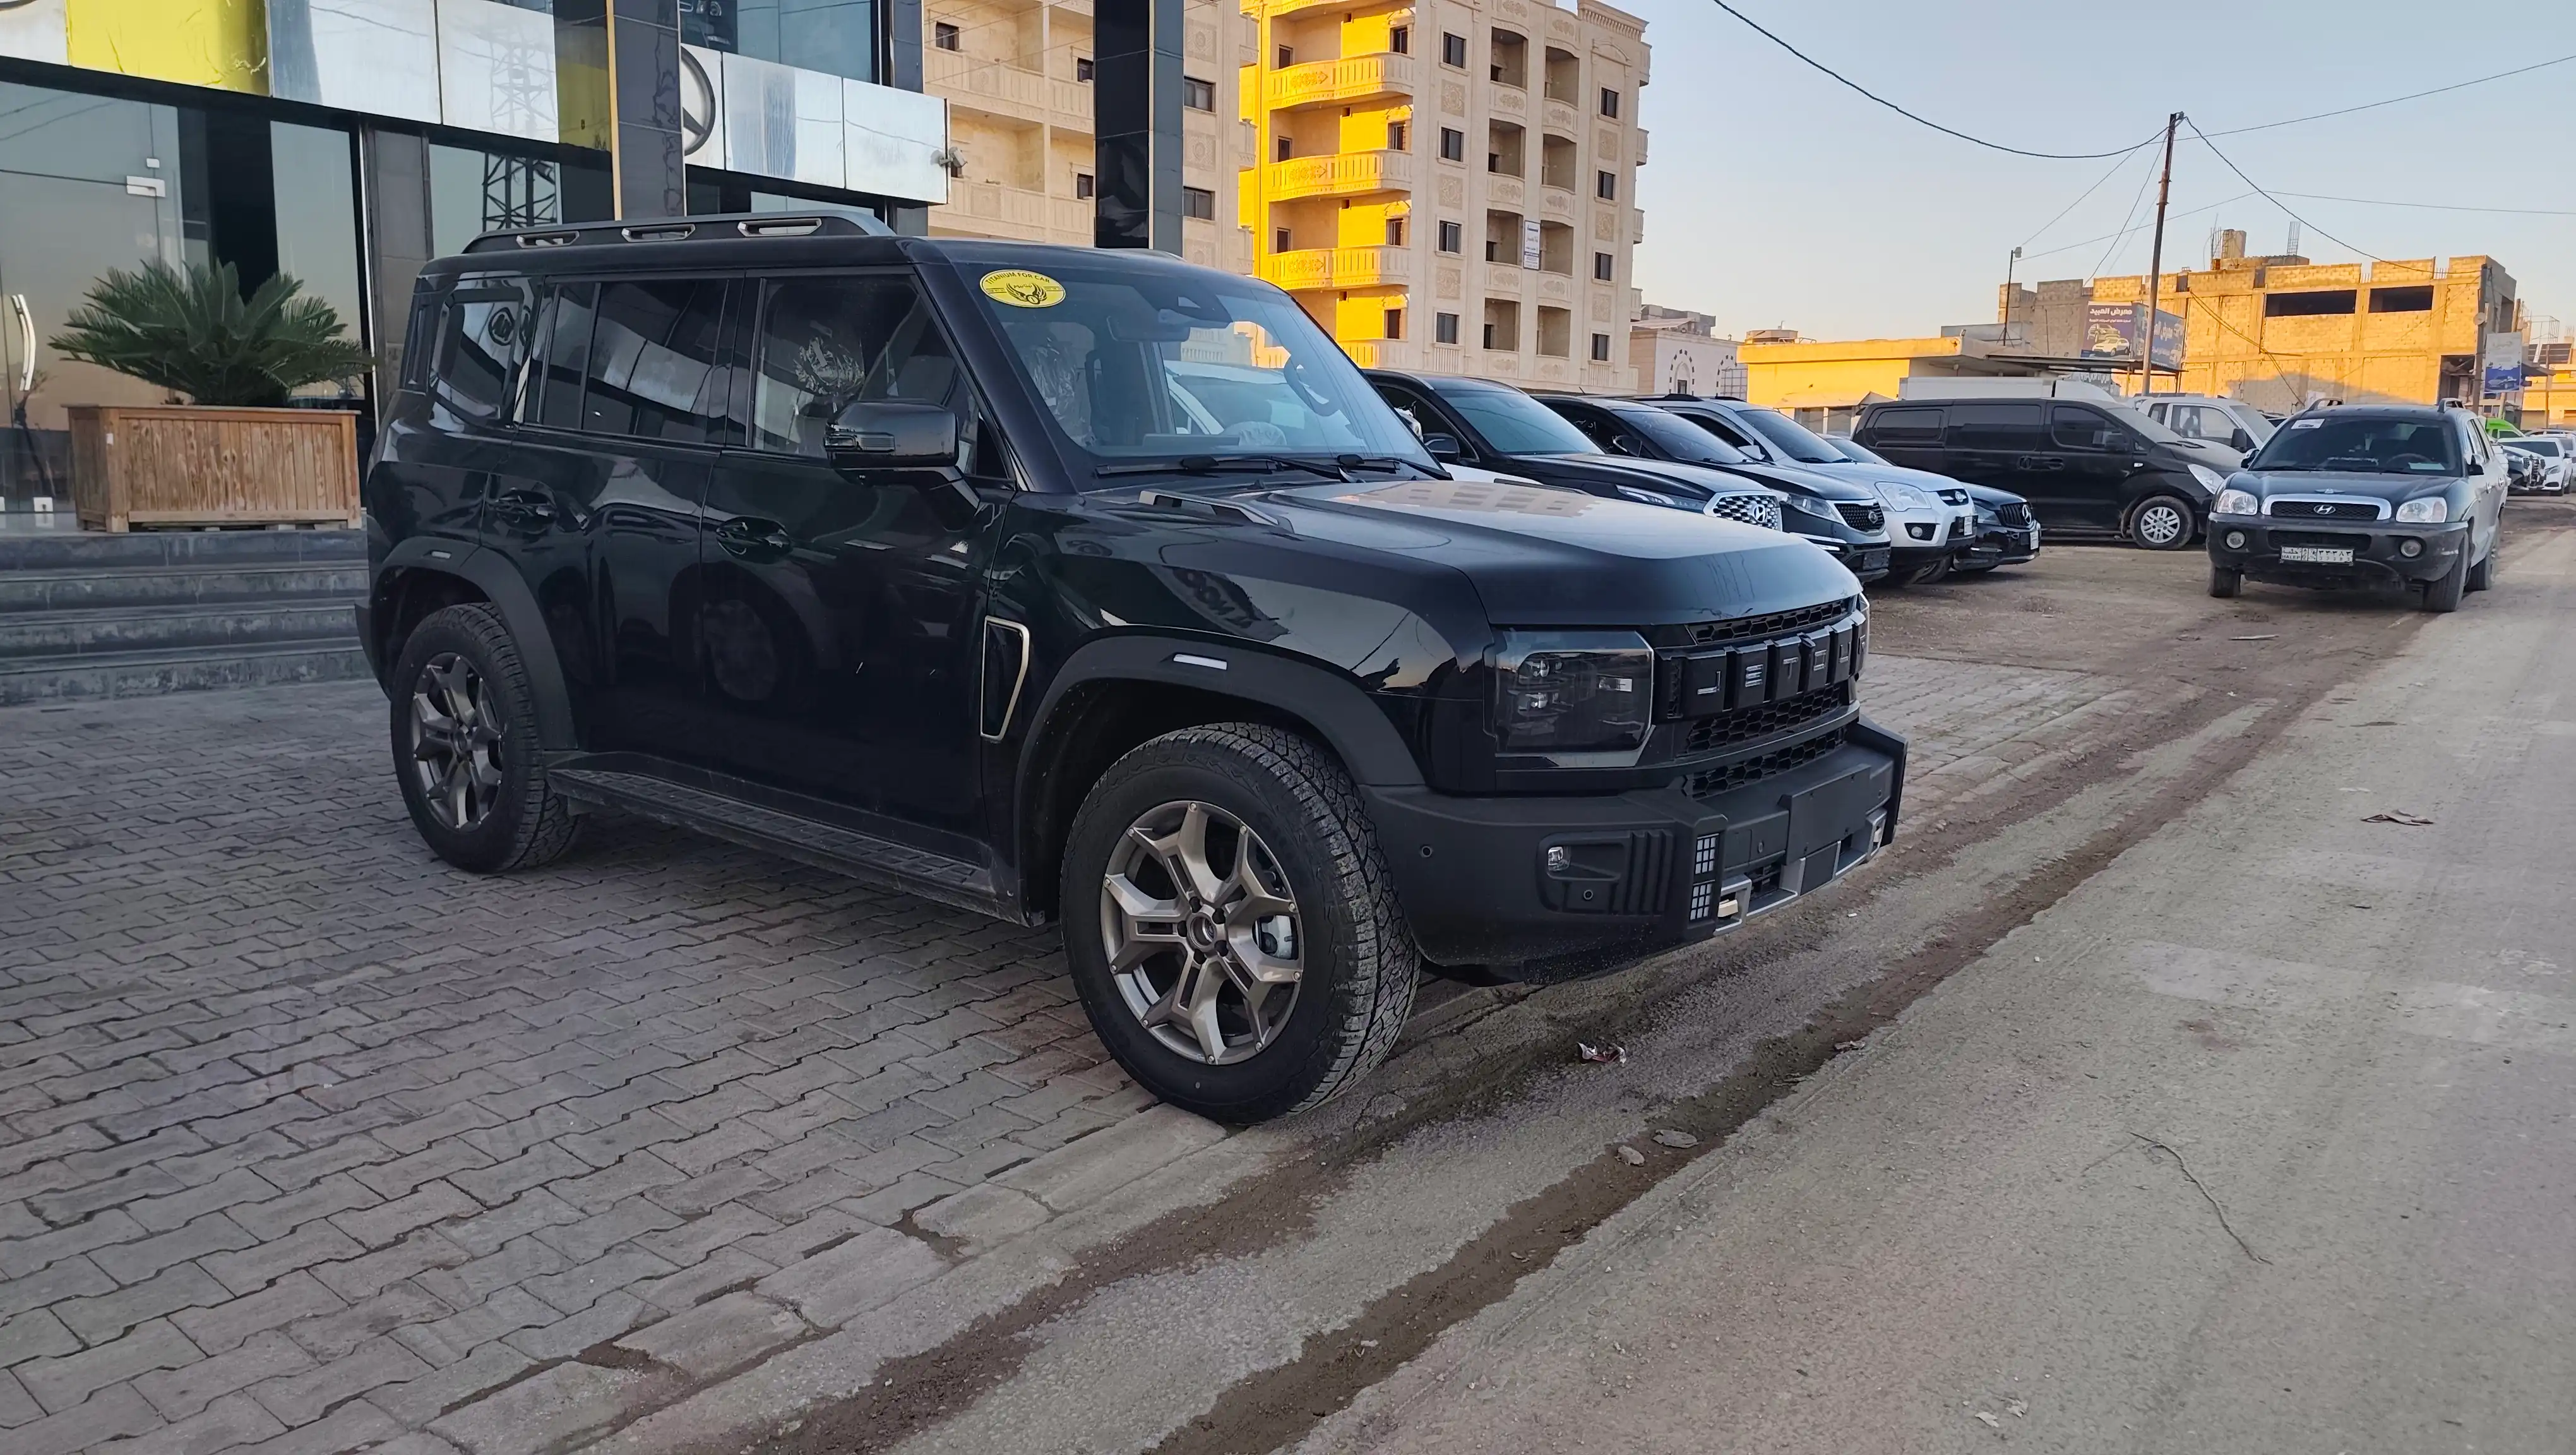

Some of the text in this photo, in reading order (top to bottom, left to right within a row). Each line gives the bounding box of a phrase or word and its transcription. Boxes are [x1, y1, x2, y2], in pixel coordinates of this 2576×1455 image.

[985, 272, 1017, 284] TITANIUM
[1034, 275, 1050, 283] CAR
[2110, 307, 2133, 316] معرض
